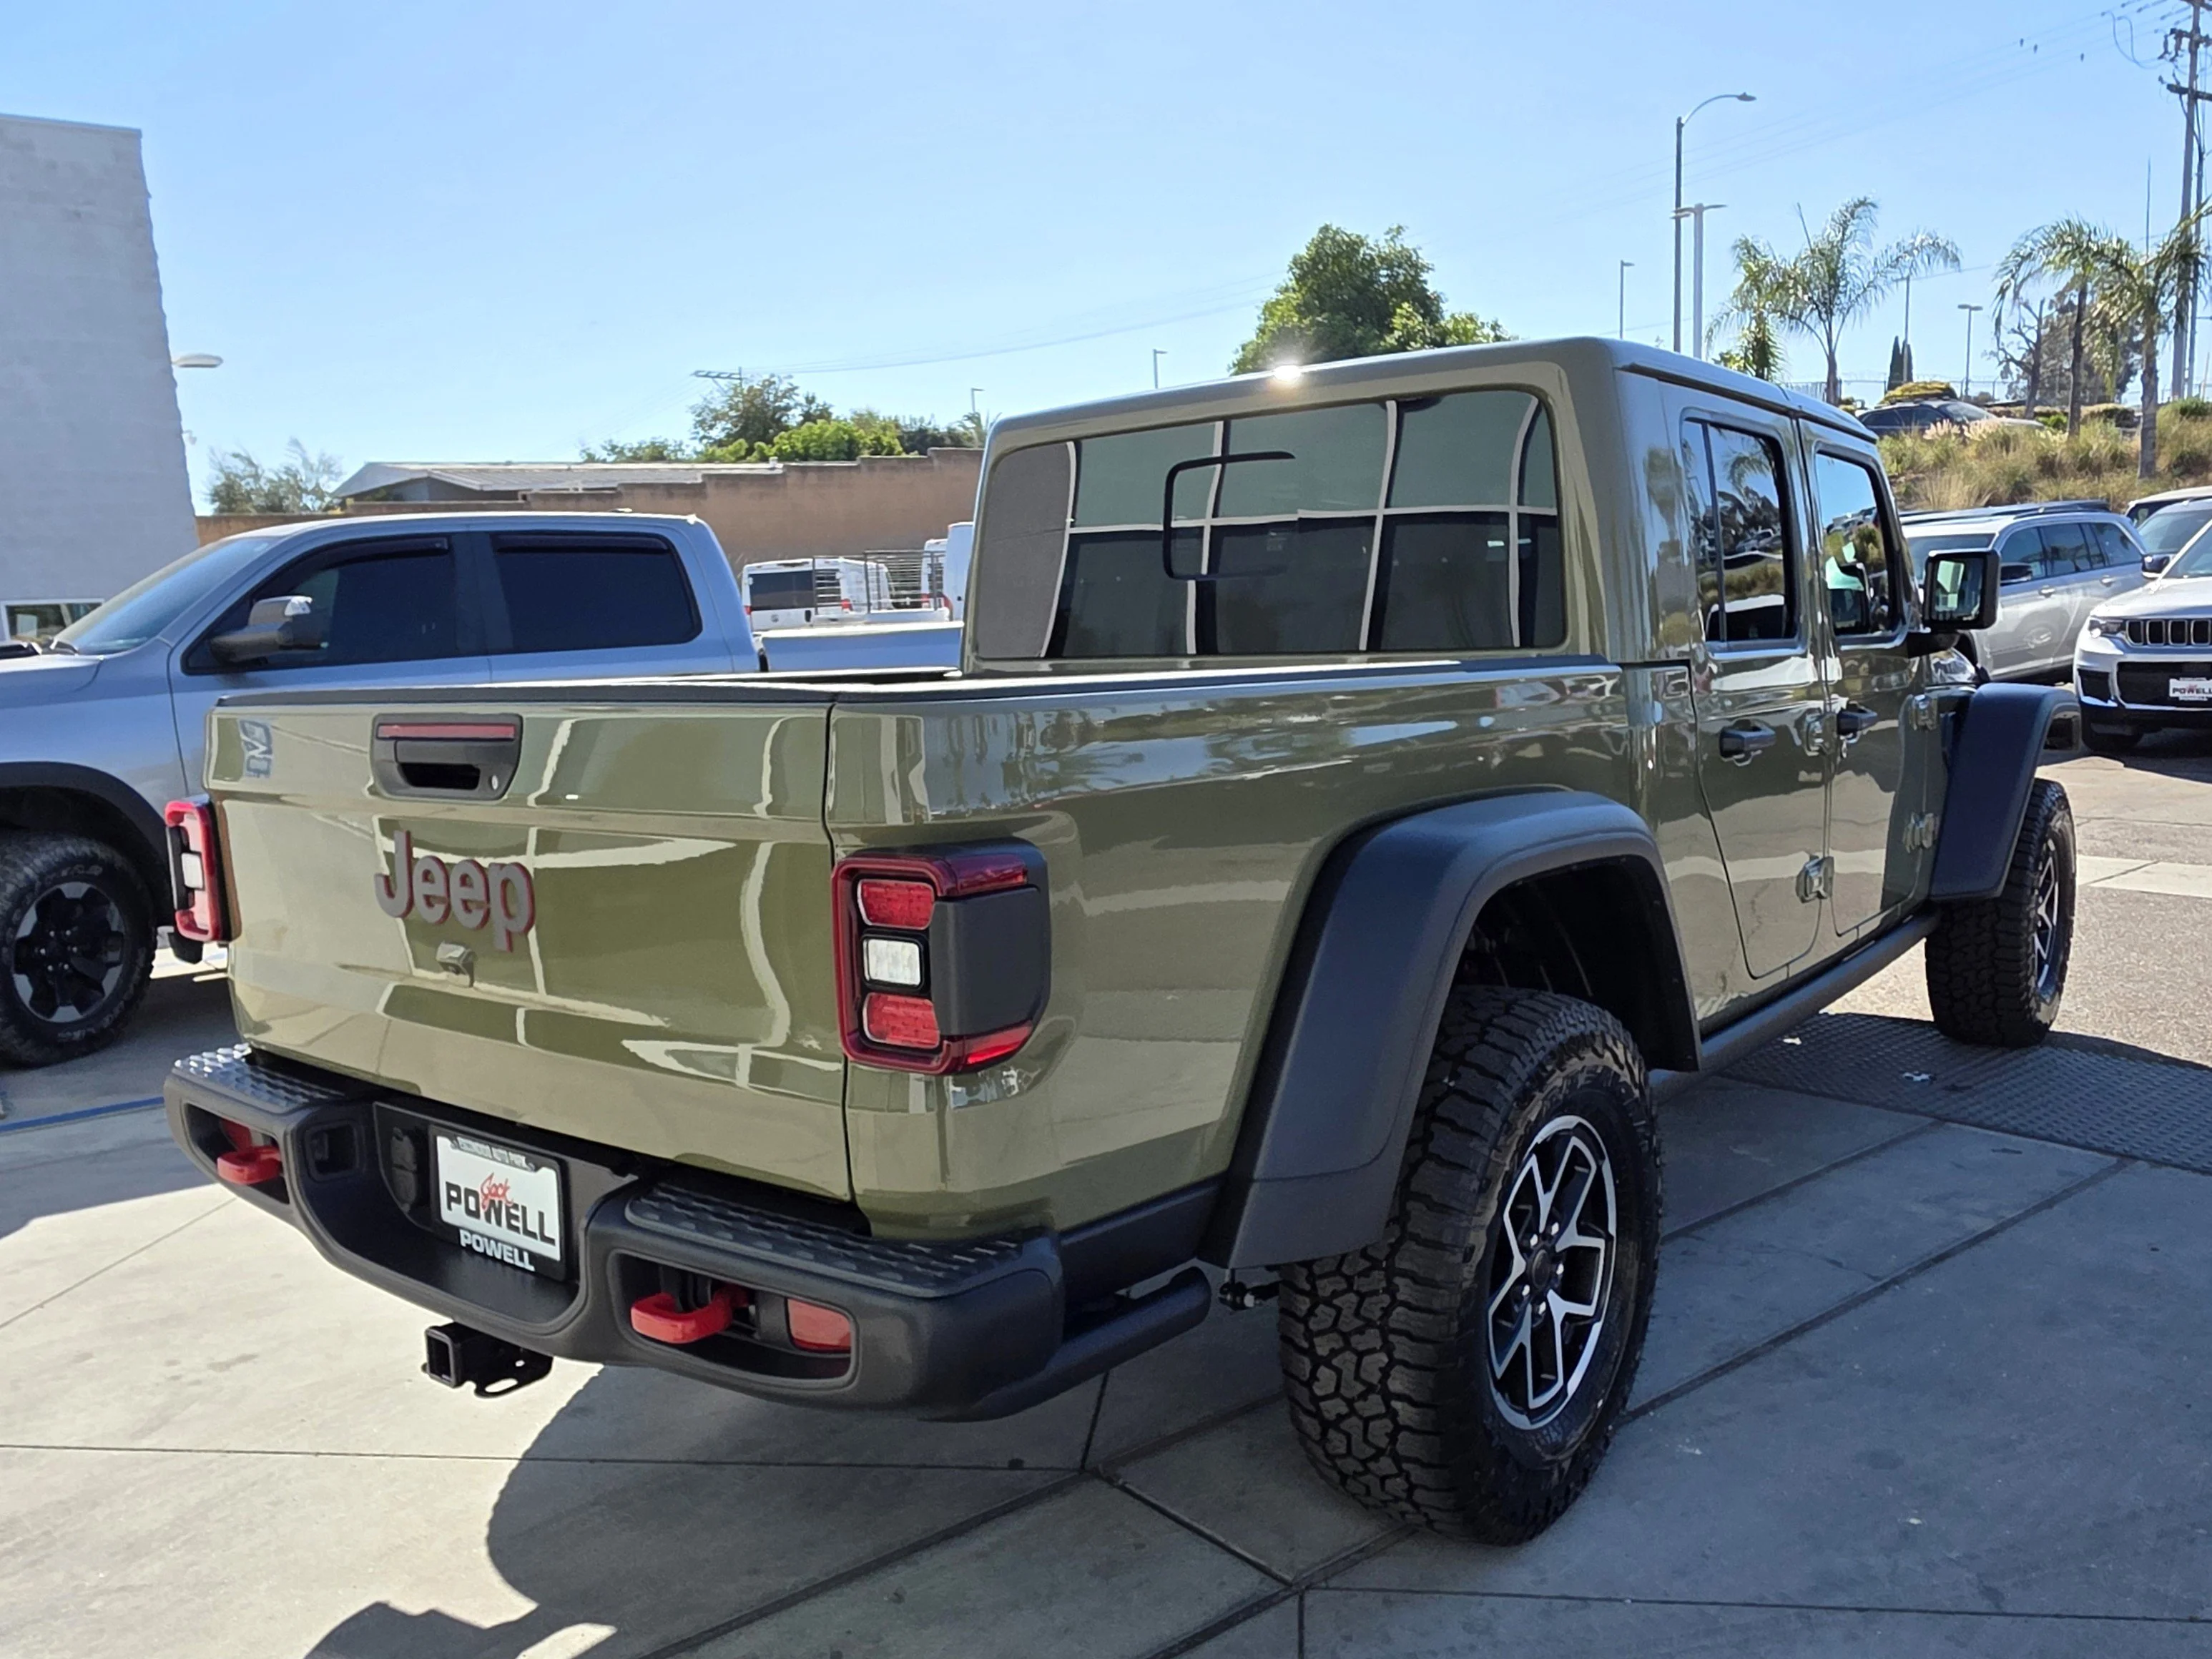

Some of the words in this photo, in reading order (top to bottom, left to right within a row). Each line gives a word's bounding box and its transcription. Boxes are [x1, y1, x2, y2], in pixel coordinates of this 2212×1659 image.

[373, 830, 535, 952] Jeep
[445, 1181, 556, 1246] POWELL
[459, 1229, 535, 1271] POWELL
